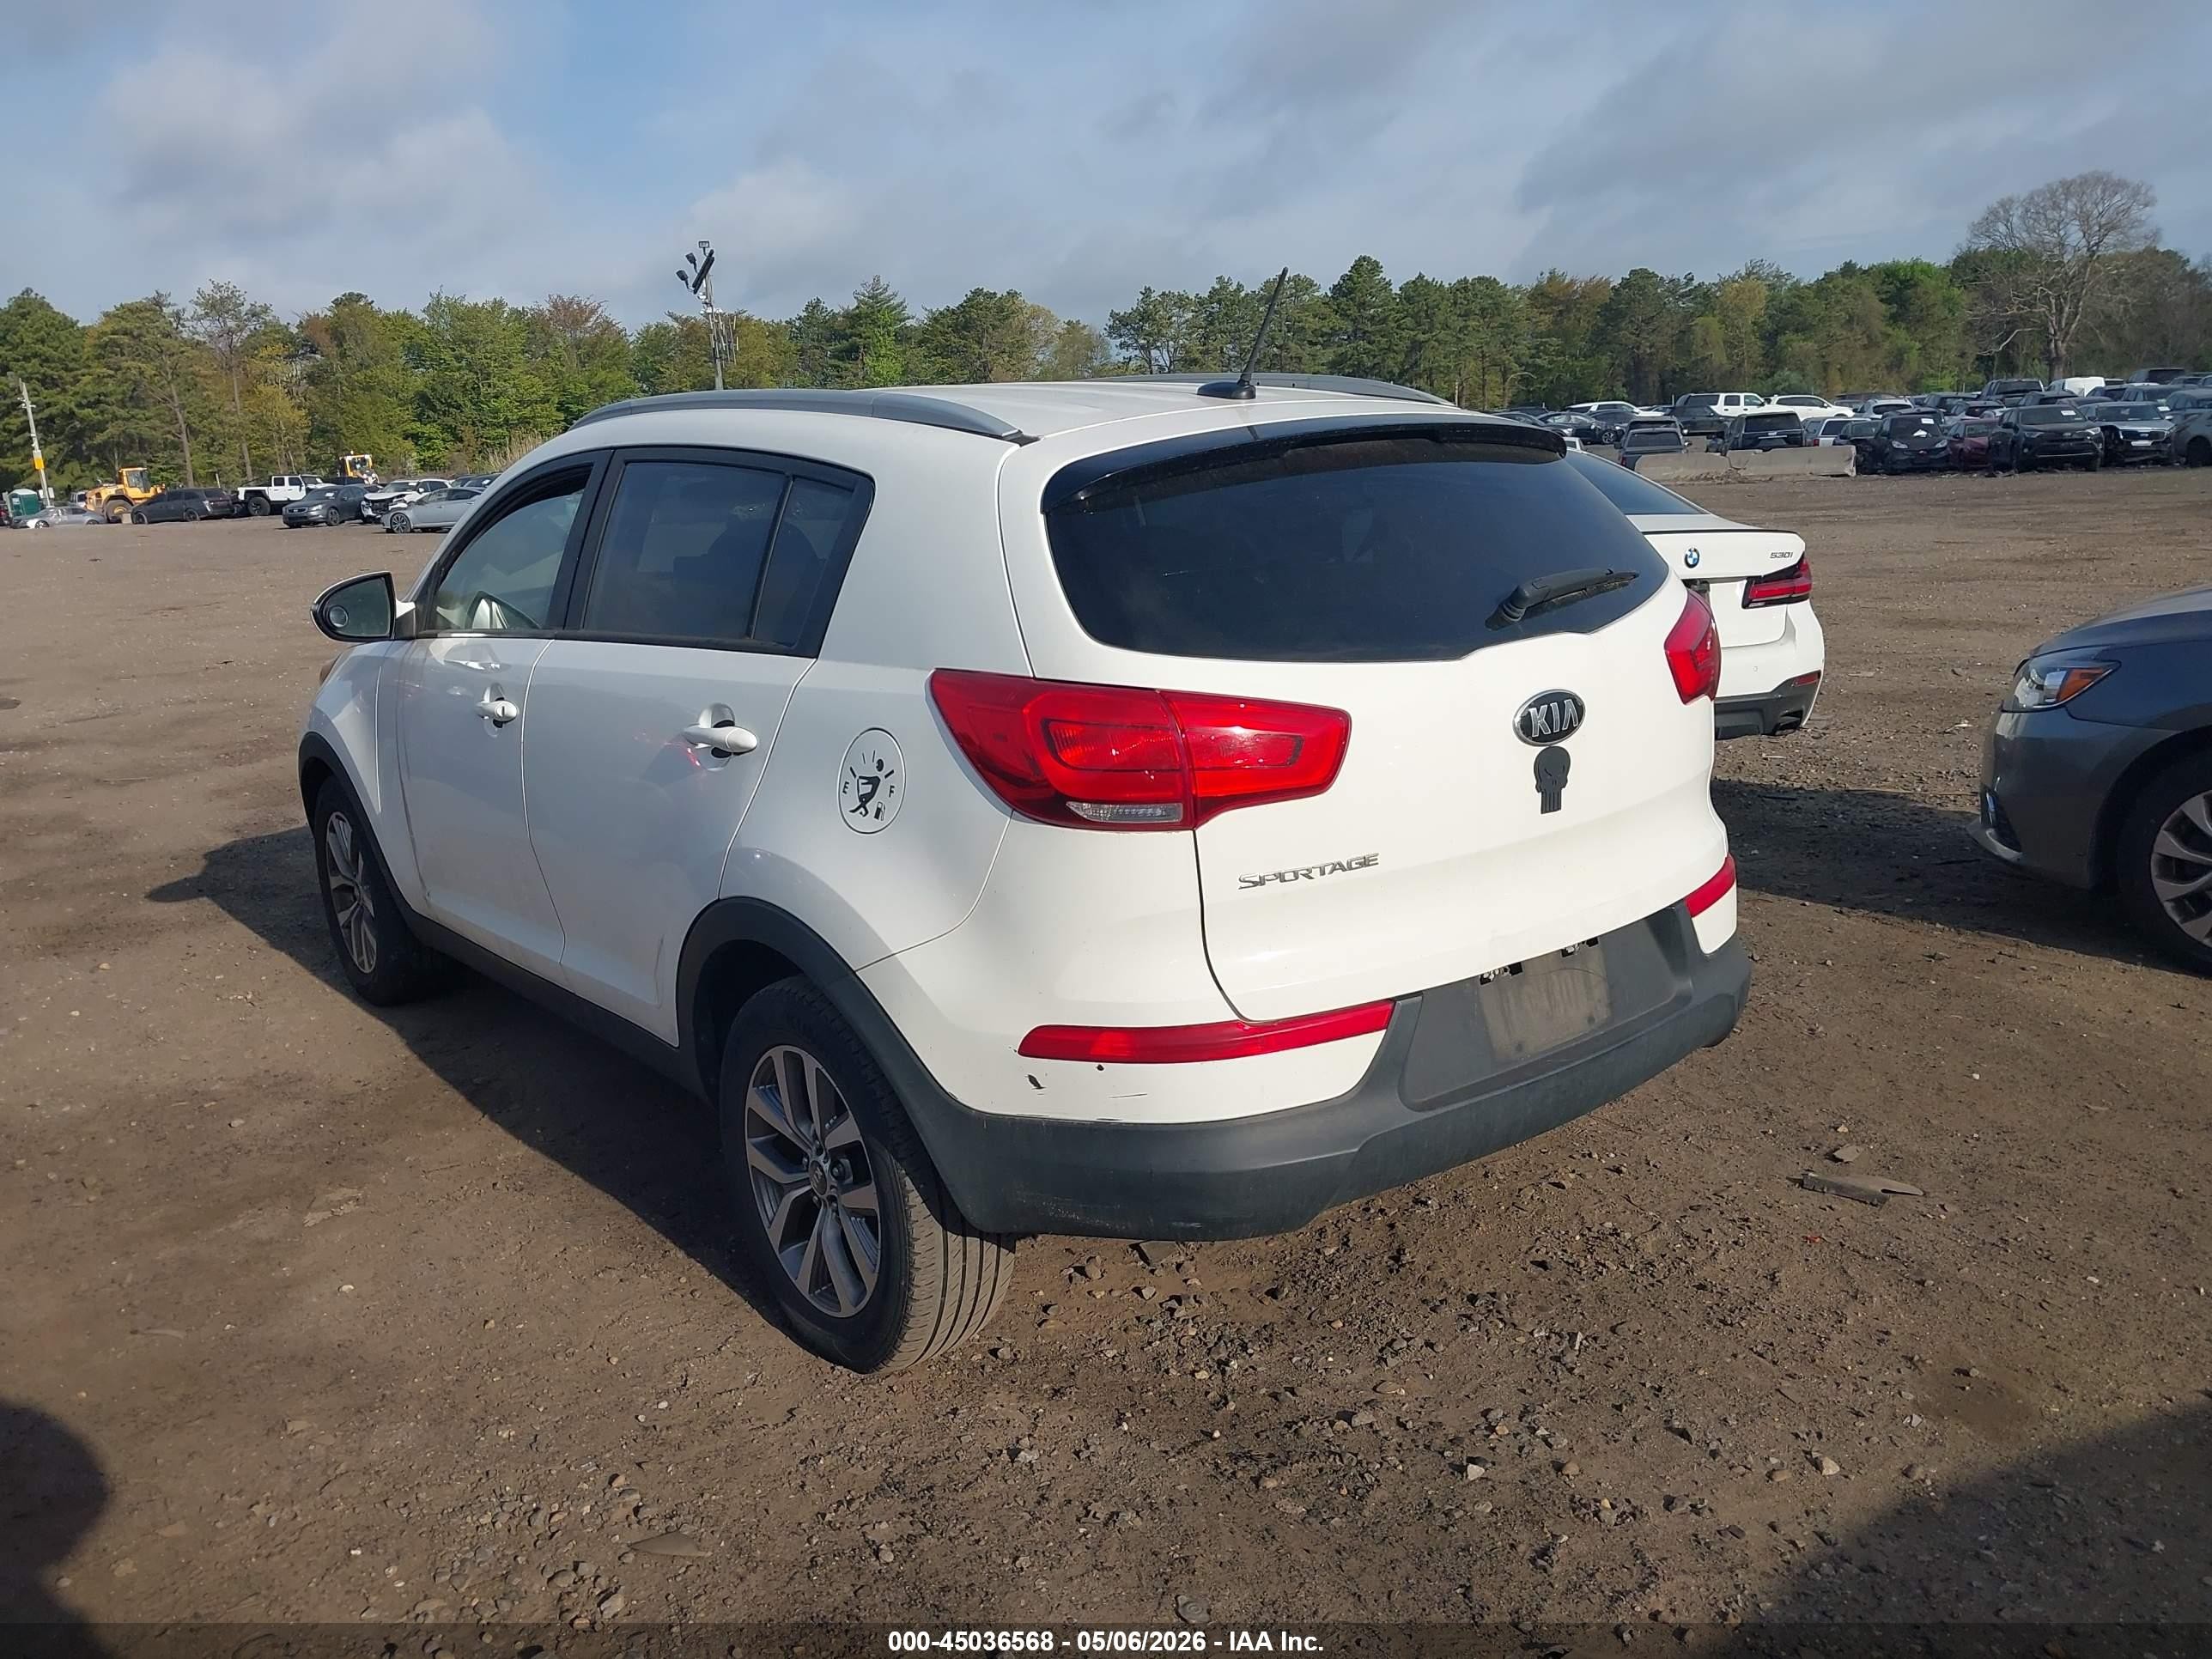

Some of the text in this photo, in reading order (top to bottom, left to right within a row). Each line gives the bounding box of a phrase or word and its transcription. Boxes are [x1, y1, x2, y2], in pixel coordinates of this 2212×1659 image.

[1528, 699, 1578, 737] KIA
[842, 781, 849, 794] E
[889, 785, 895, 798] F
[1238, 853, 1379, 890] SPORTAGE
